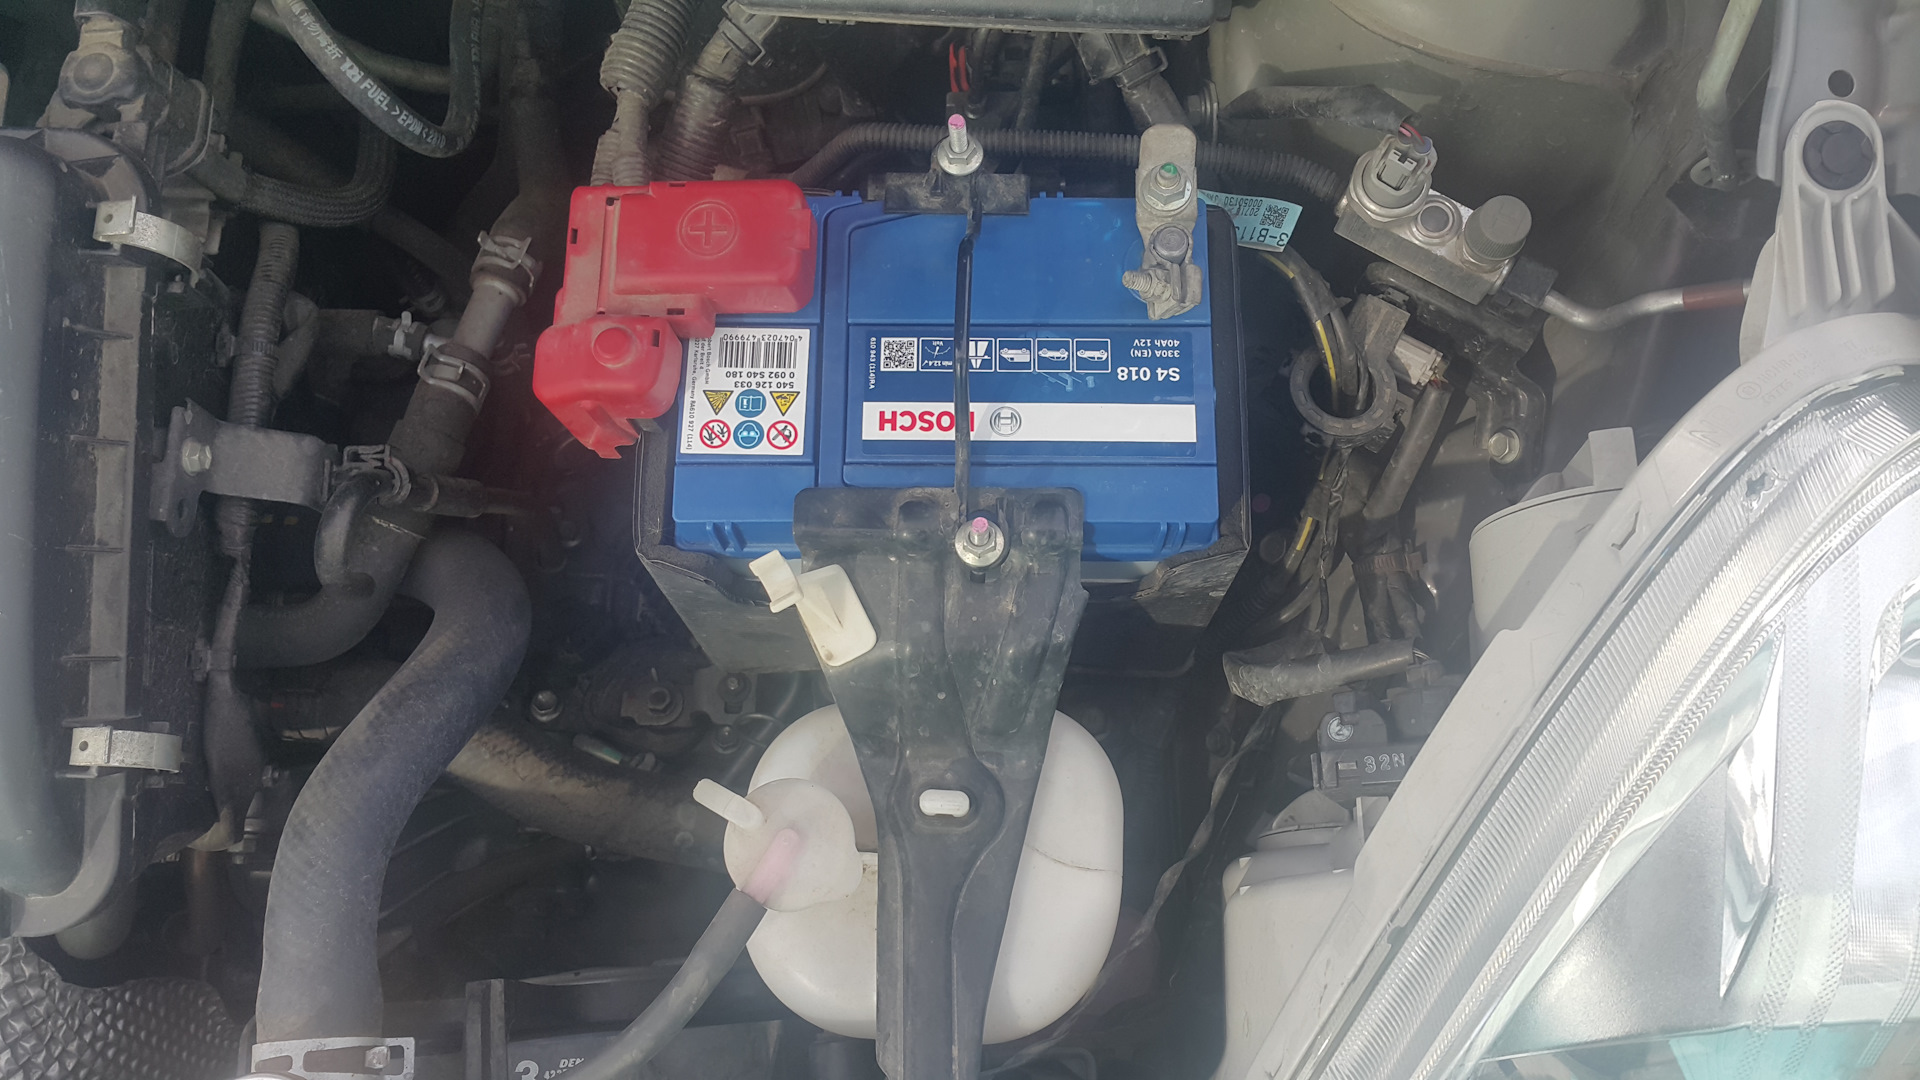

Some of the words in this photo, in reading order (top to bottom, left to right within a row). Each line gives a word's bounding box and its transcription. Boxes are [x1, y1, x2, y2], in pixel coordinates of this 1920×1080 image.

[360, 78, 391, 111] FUEL
[1236, 226, 1289, 247] 3-B11
[1133, 339, 1152, 347] 12V
[1154, 339, 1180, 347] 40Ah
[1130, 348, 1152, 357] (EN)
[1116, 366, 1151, 381] 018
[1155, 367, 1180, 381] S4
[879, 410, 975, 432] OSCH
